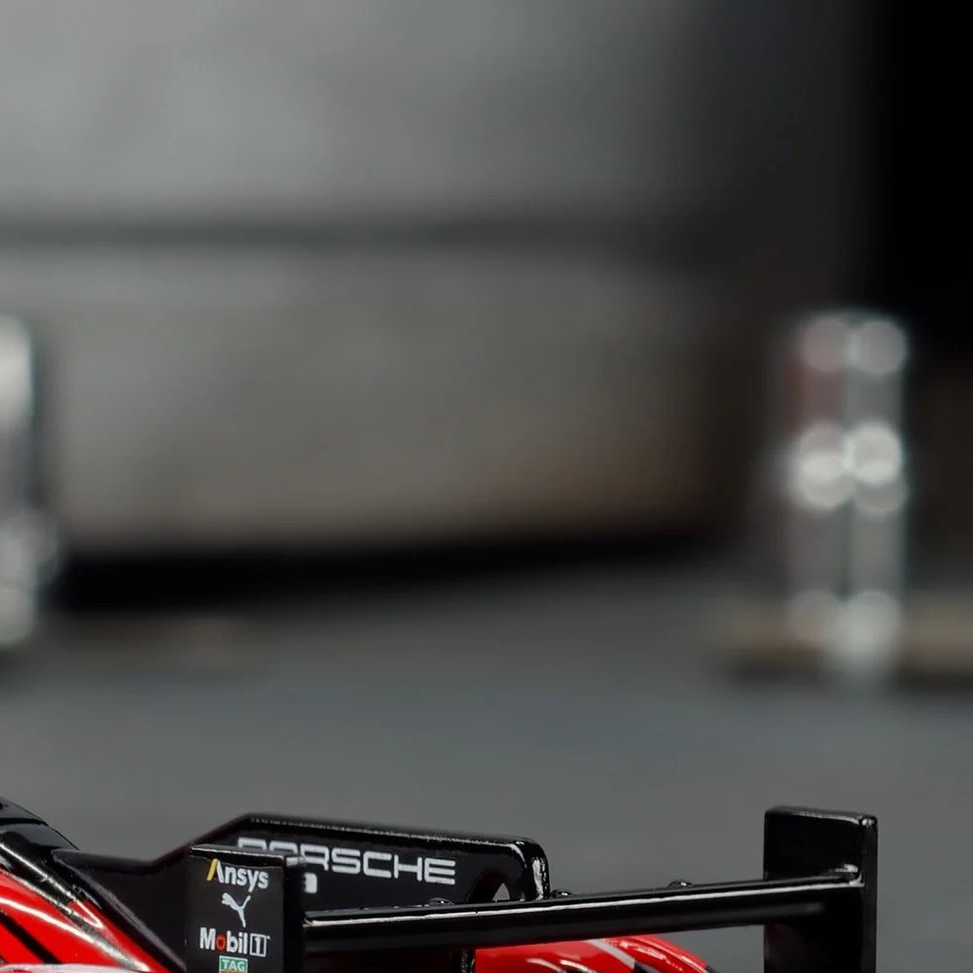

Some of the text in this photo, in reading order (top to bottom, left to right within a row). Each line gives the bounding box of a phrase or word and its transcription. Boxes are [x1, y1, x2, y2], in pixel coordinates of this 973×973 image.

[207, 858, 269, 893] Ansys
[200, 927, 248, 954] Mobil
[222, 959, 246, 973] TAG
